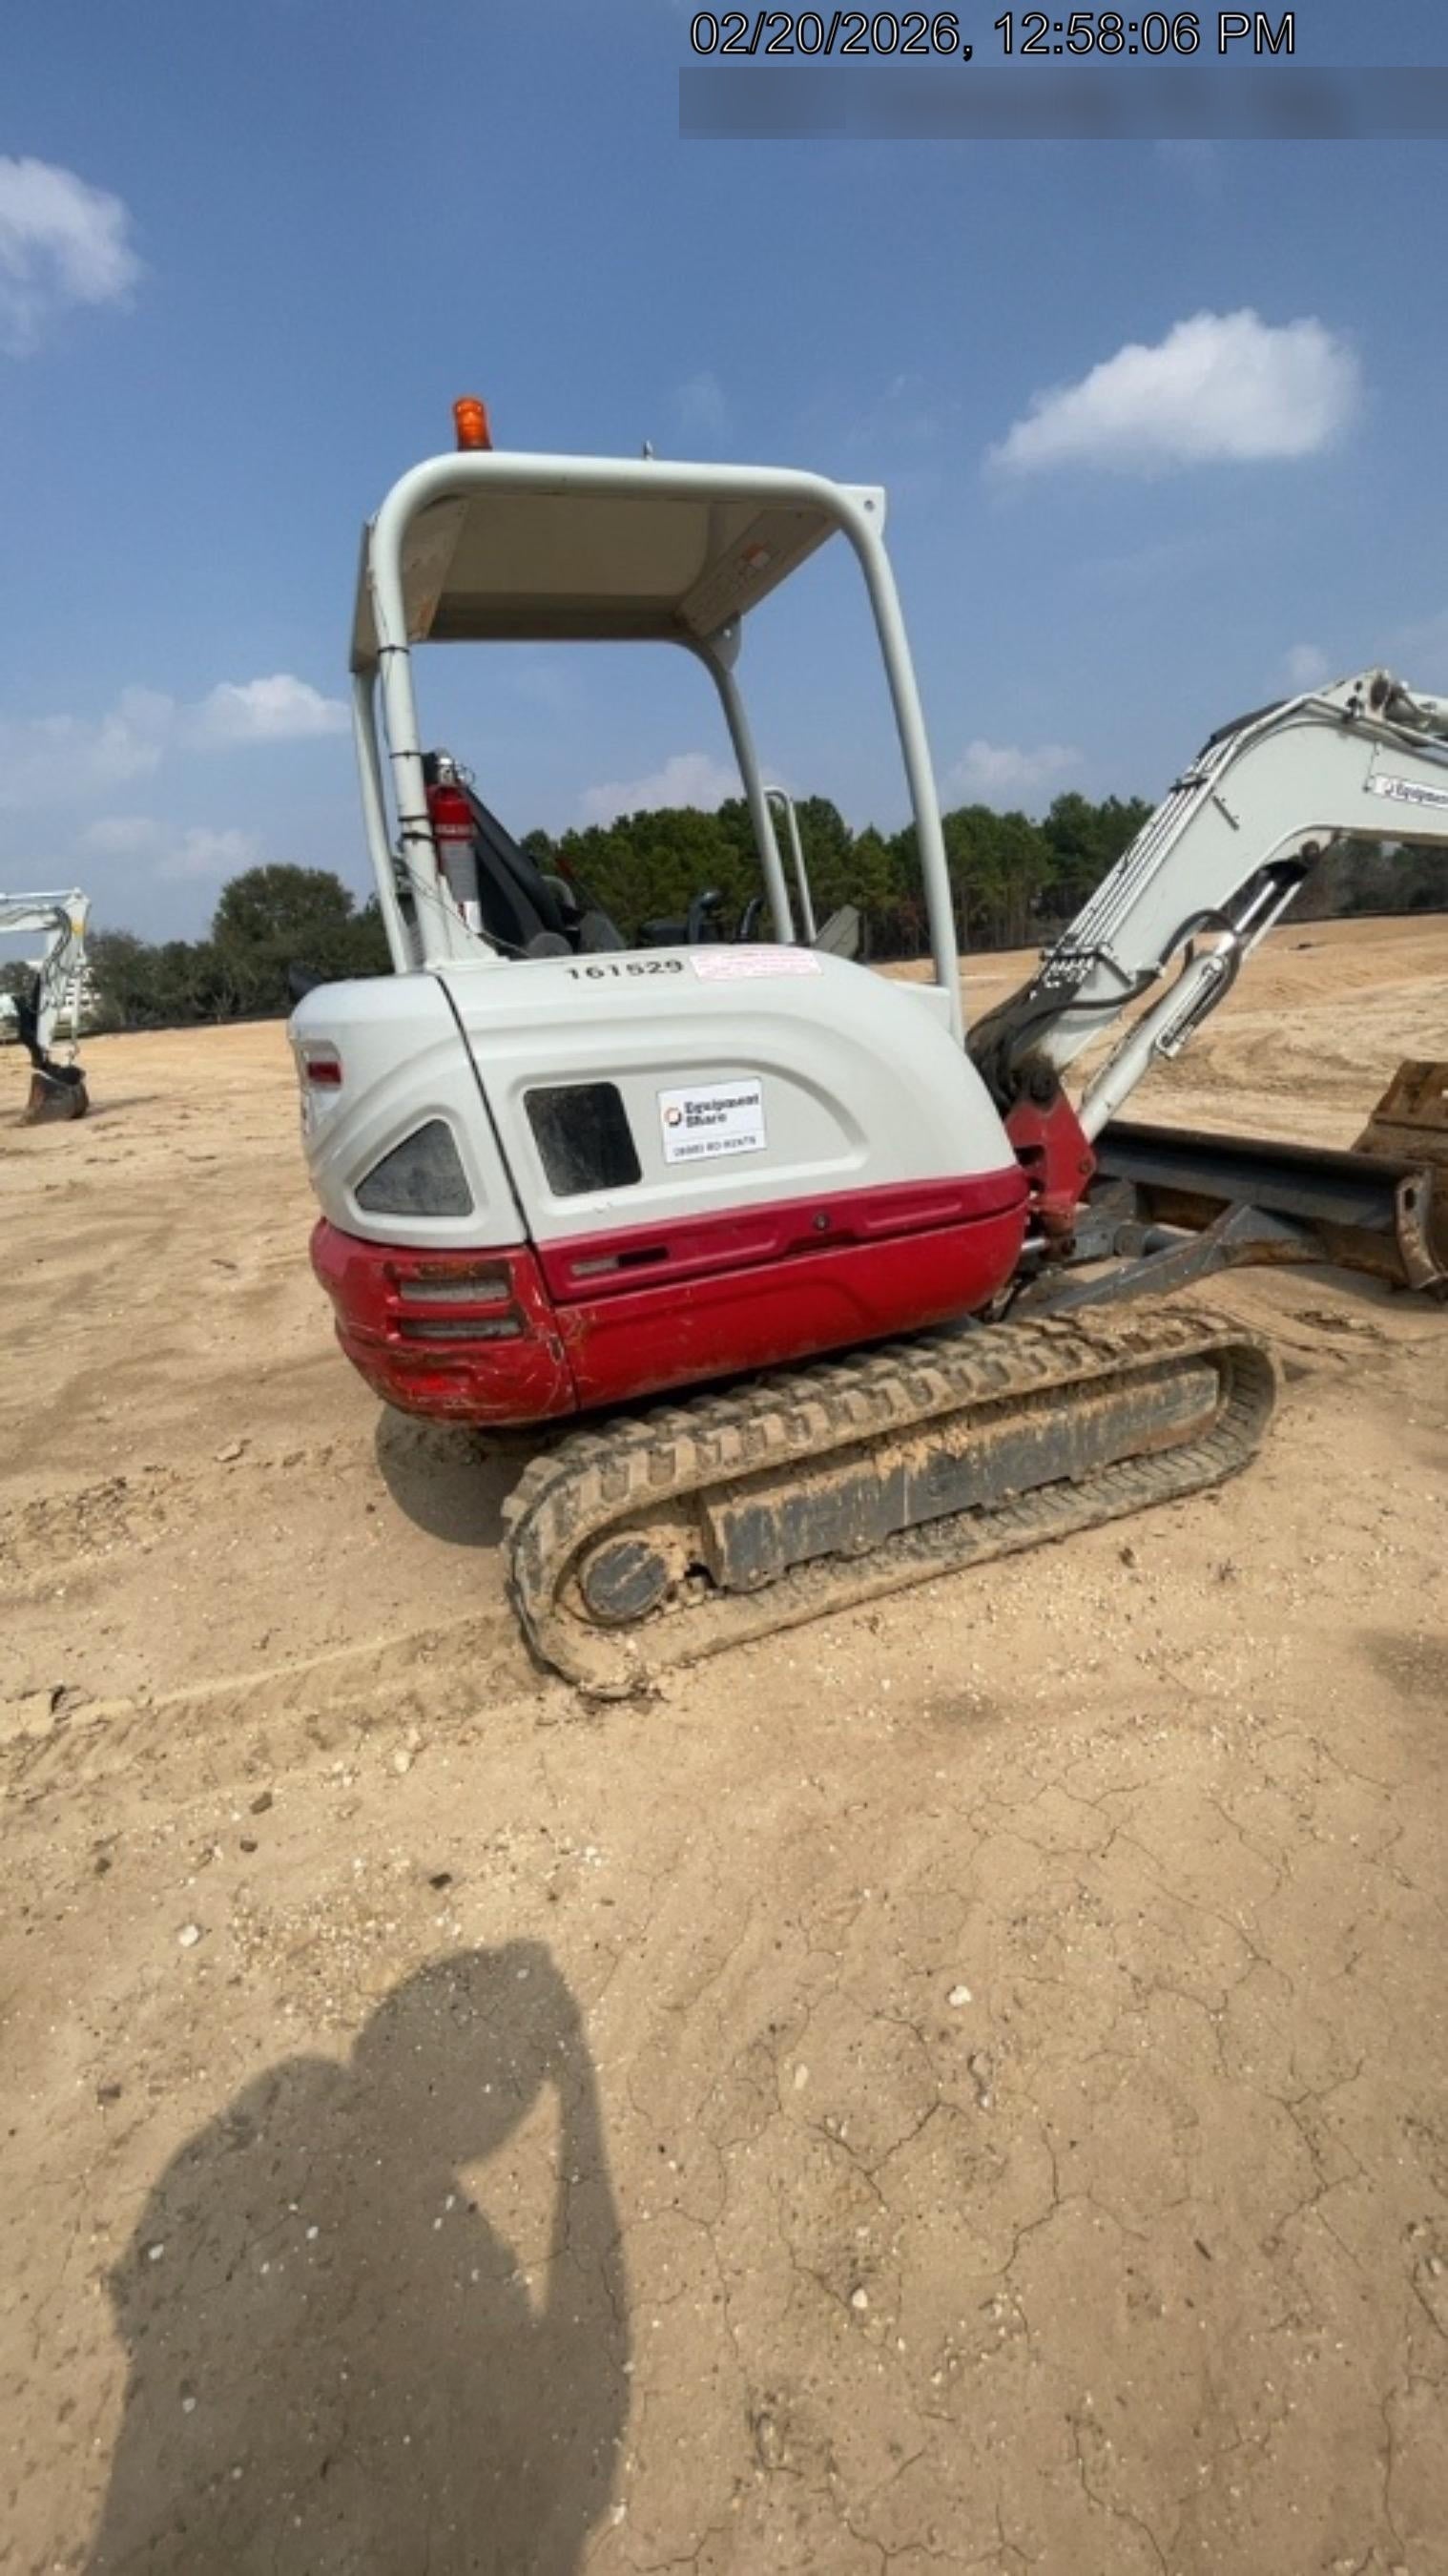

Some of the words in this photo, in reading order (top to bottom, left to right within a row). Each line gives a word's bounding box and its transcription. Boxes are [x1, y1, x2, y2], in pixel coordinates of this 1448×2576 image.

[564, 959, 684, 980] 161529
[684, 1093, 759, 1114] Equipment
[686, 1112, 727, 1129] Share
